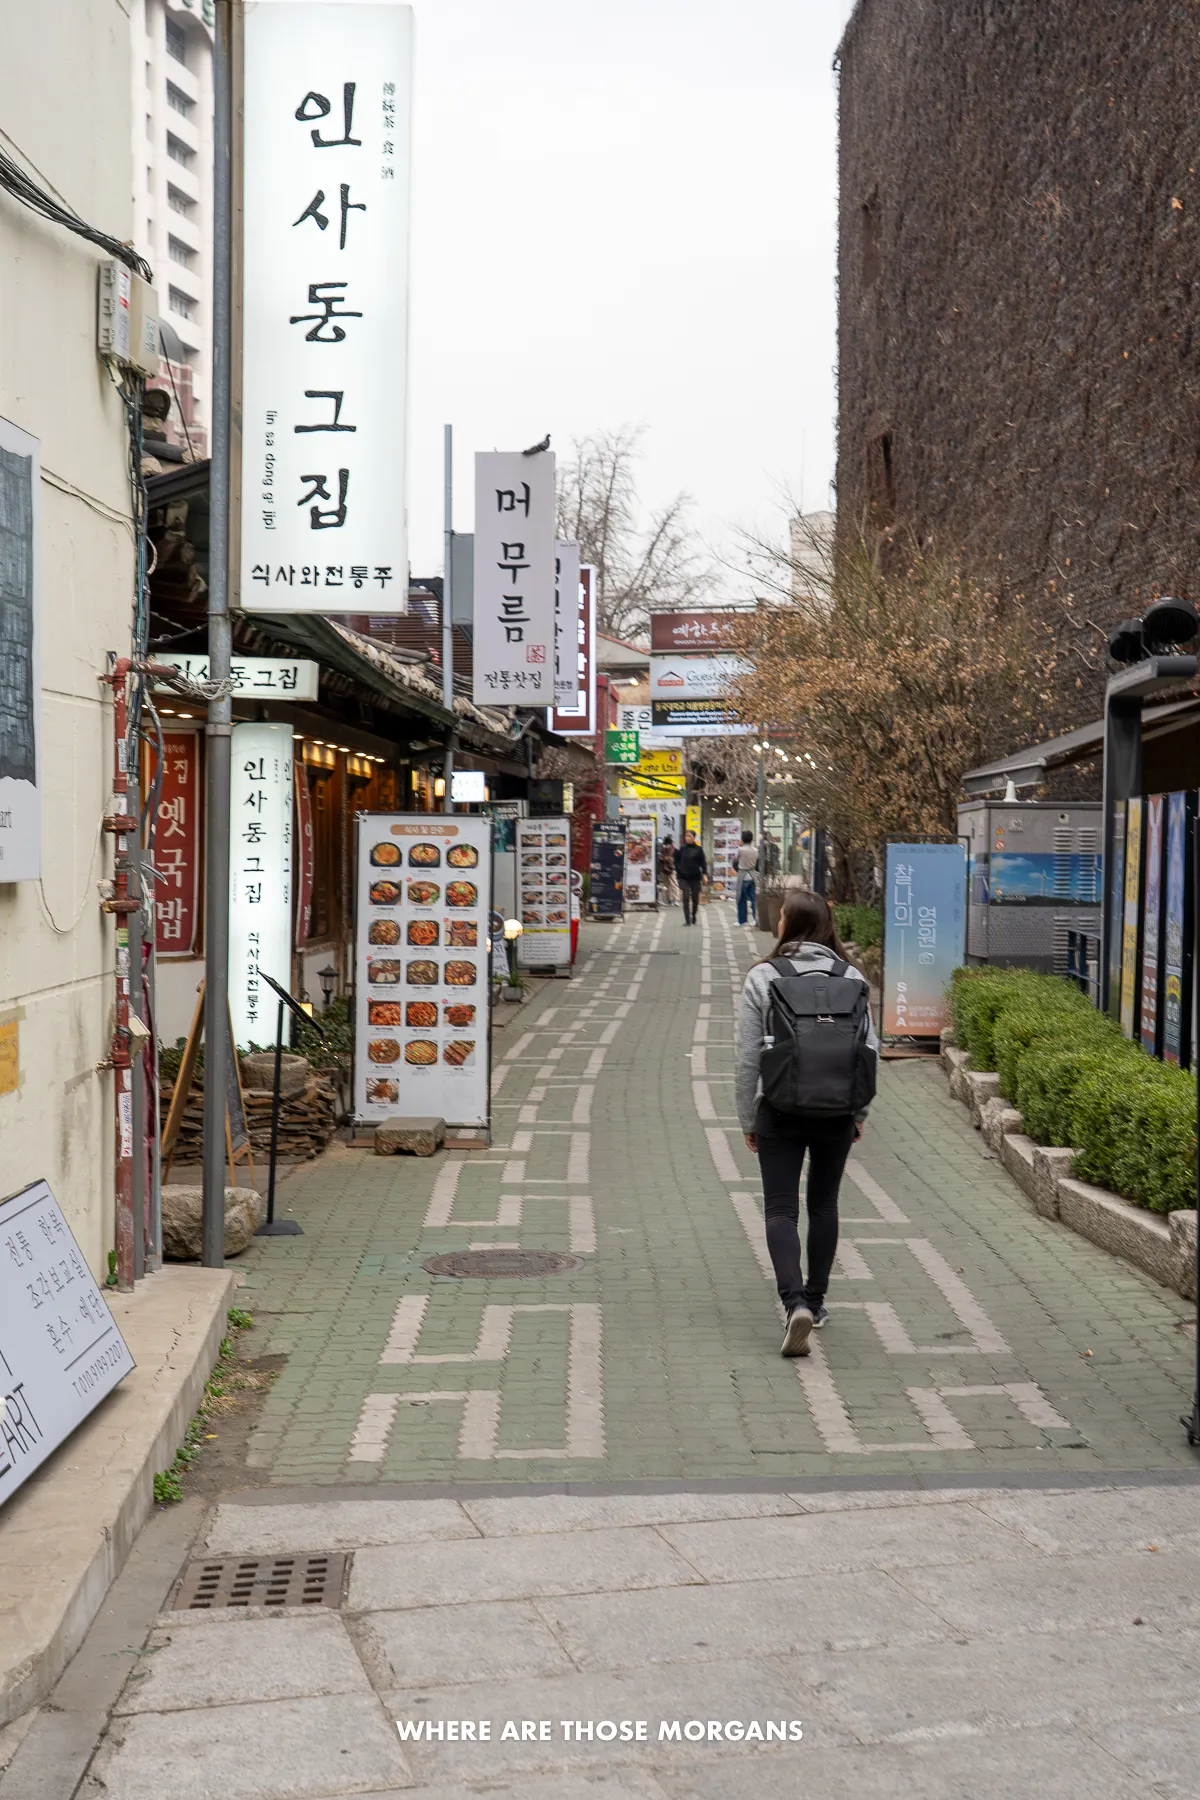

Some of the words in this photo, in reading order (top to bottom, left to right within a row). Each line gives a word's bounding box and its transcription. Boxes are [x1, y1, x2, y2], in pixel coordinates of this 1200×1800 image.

[290, 82, 366, 529] 인사동그집
[251, 564, 393, 589] 식사와전통주
[496, 481, 531, 643] 머무름
[483, 671, 542, 689] 전통찻집
[156, 797, 189, 938] 옛국밥
[242, 758, 267, 904] 인사동그집
[5, 1230, 33, 1268] 전통
